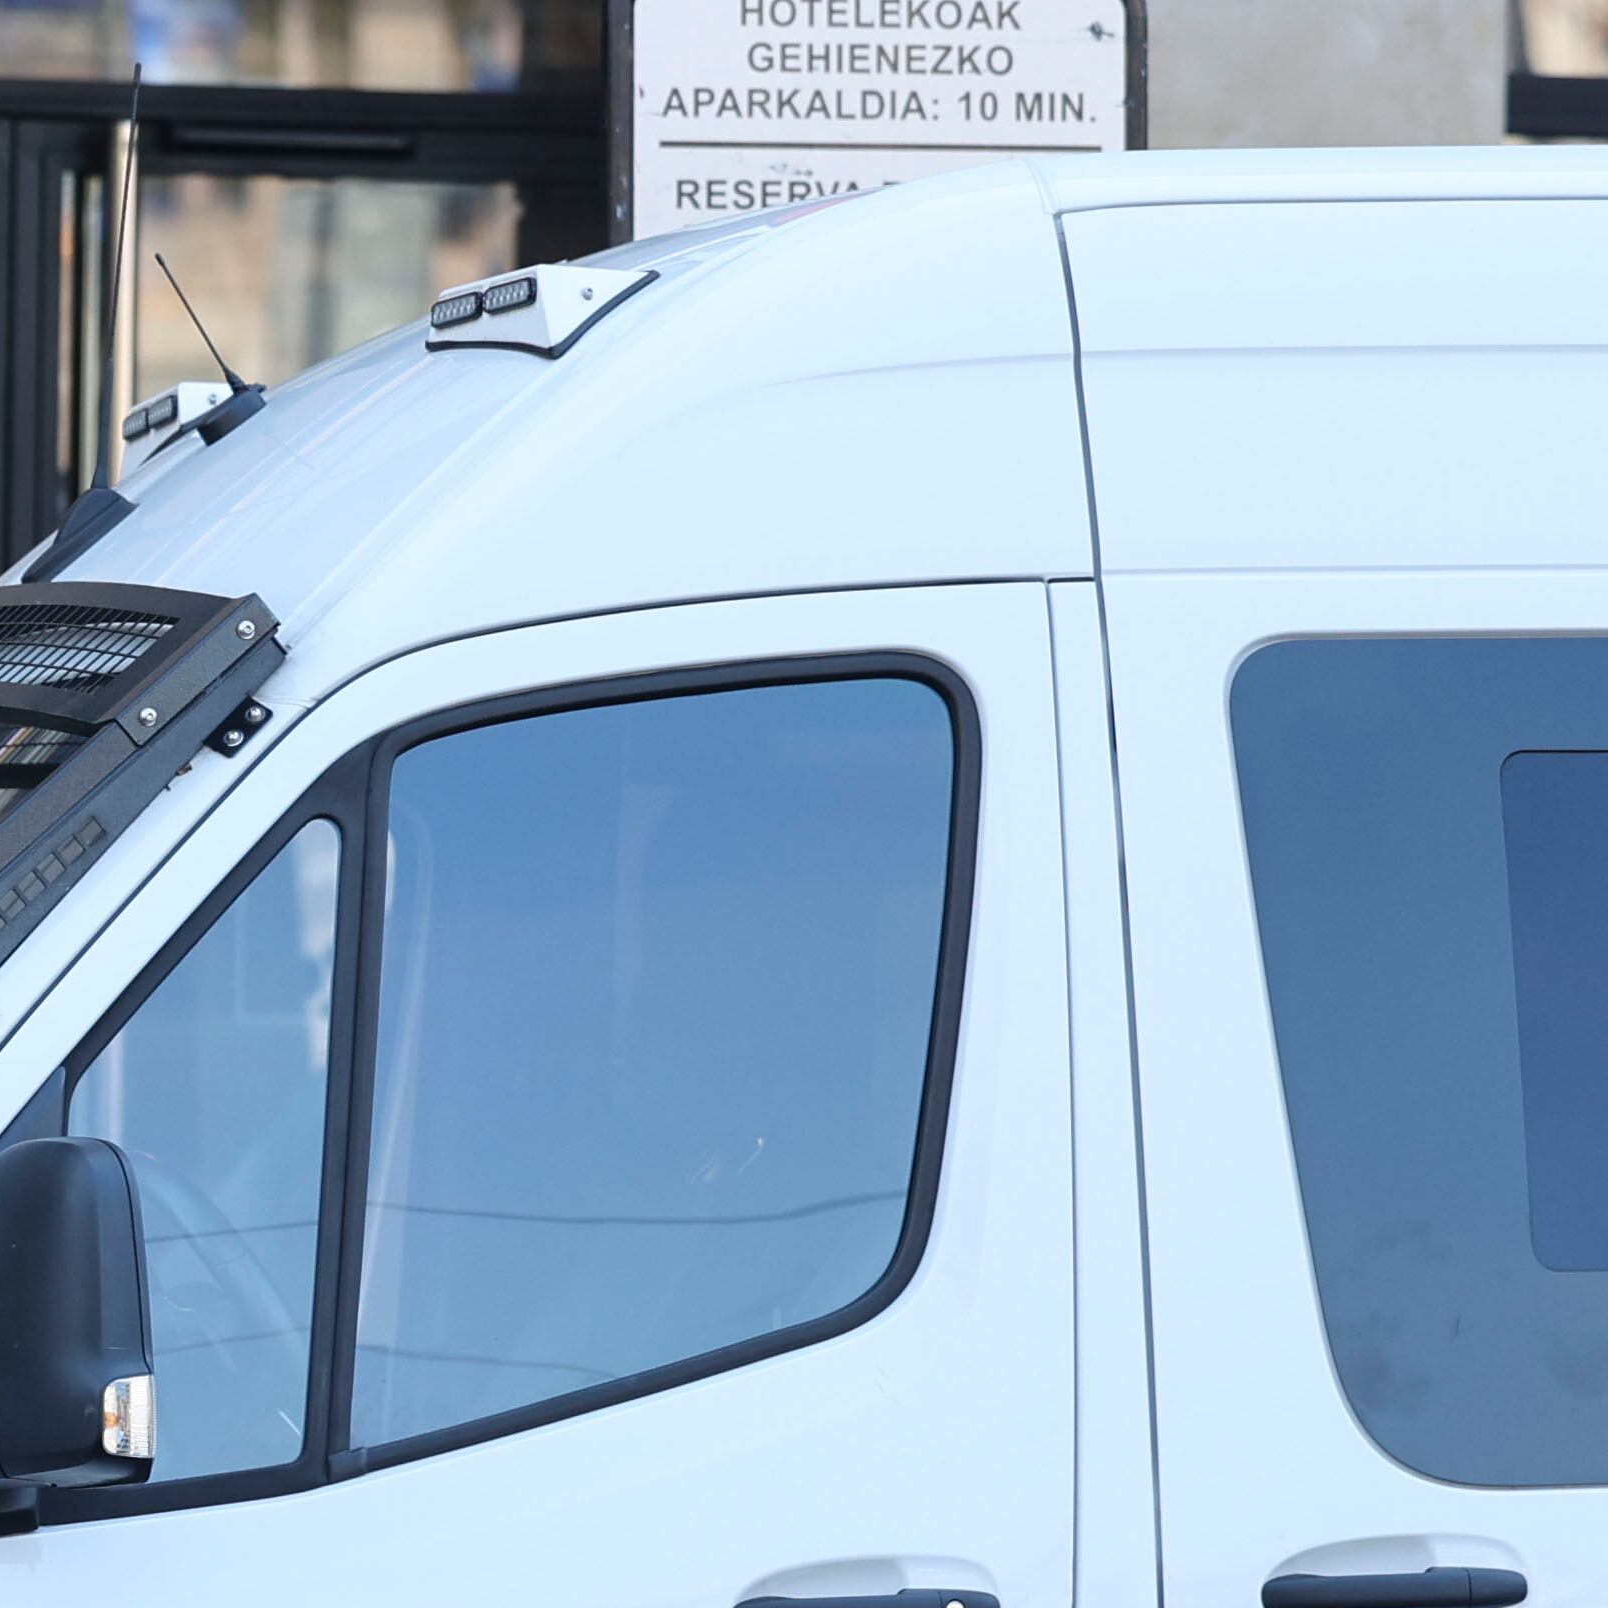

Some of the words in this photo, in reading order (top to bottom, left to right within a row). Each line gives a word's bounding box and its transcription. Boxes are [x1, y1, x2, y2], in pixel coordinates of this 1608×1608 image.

[740, 0, 1022, 31] HOTELEKOAK
[747, 43, 1015, 76] GEHIENEZKO
[661, 88, 942, 120] APARKALDIA:
[958, 92, 999, 122] 10
[1014, 92, 1098, 123] MIN.
